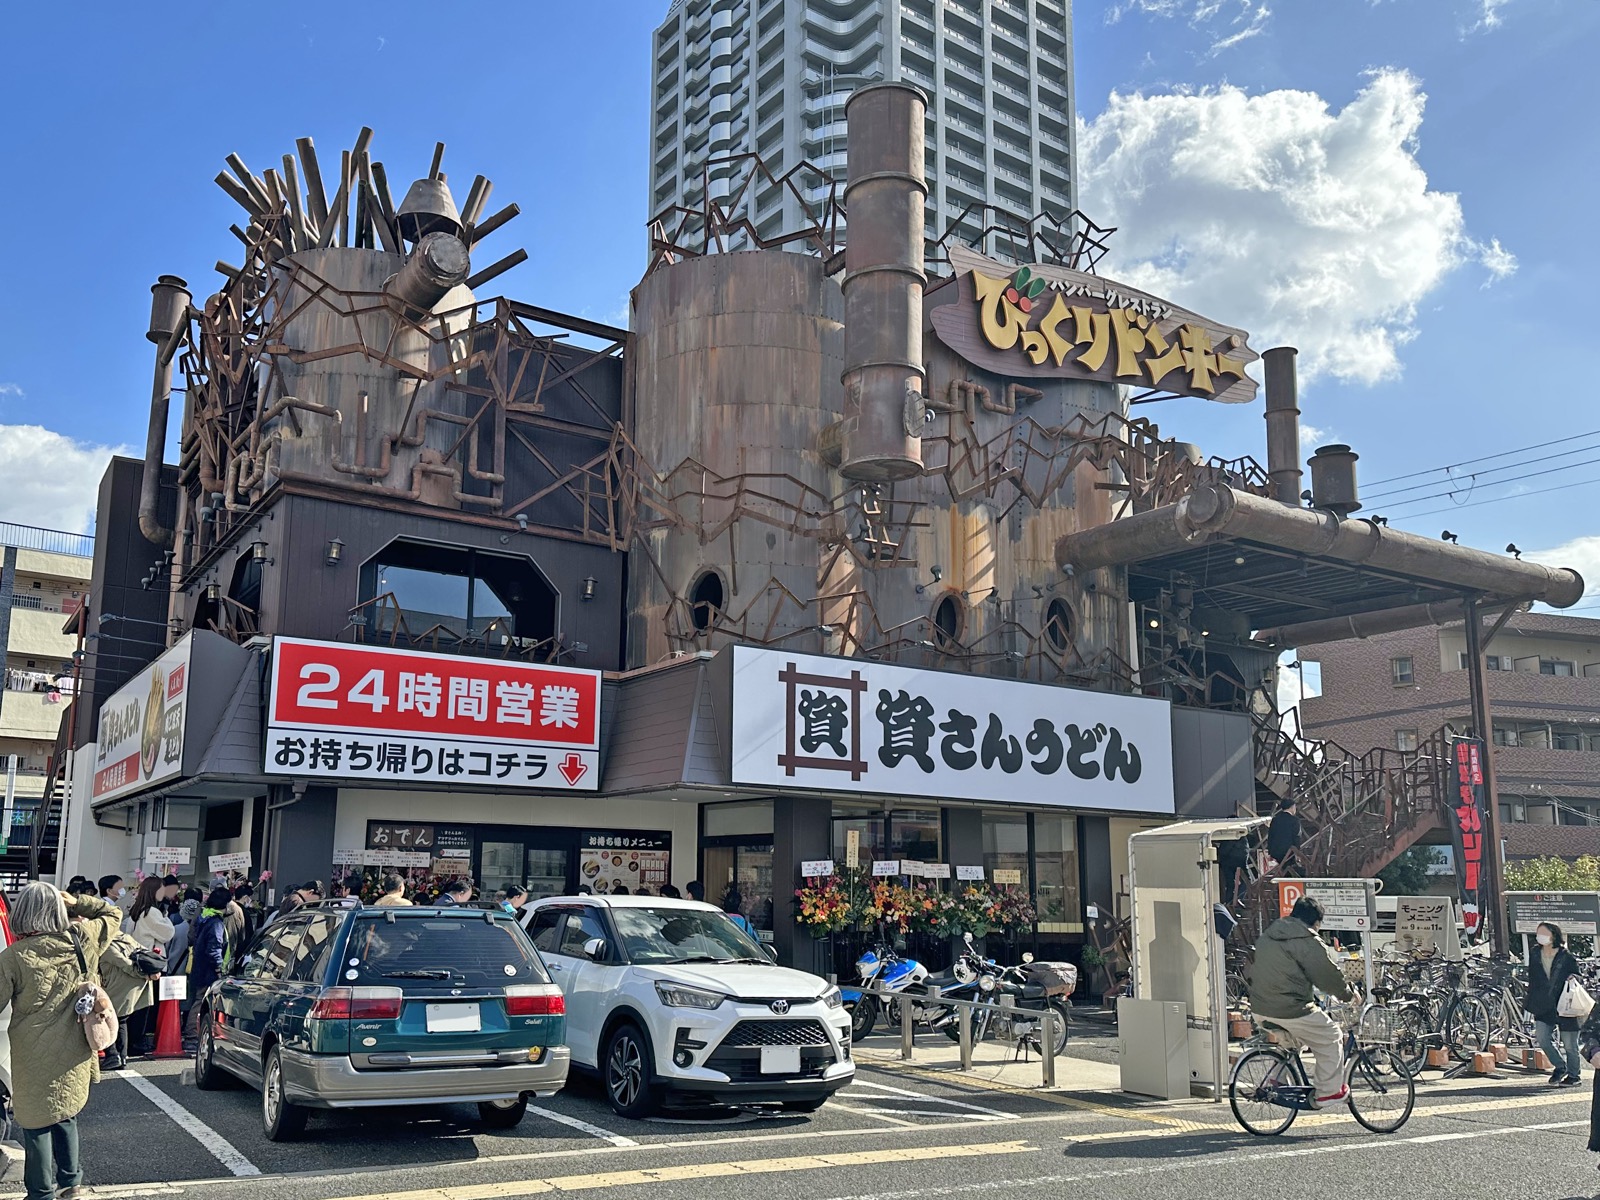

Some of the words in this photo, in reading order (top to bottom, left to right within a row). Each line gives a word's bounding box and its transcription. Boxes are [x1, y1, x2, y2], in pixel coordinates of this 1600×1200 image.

[1049, 279, 1173, 320] ハンバーグレストラン
[970, 267, 1246, 394] びっくりドンキー
[296, 662, 580, 729] 24時間営業
[107, 697, 141, 752] 資さんうどん
[799, 689, 848, 758] 資
[875, 688, 1142, 784] 資さんうどん
[101, 761, 127, 791] 24時間営業
[274, 736, 548, 781] お持ち帰りはコチラ
[373, 826, 431, 846] おでん
[588, 835, 663, 847] お持ち帰りメニュー
[1401, 904, 1445, 913] モーニング
[1407, 914, 1440, 922] メニュー
